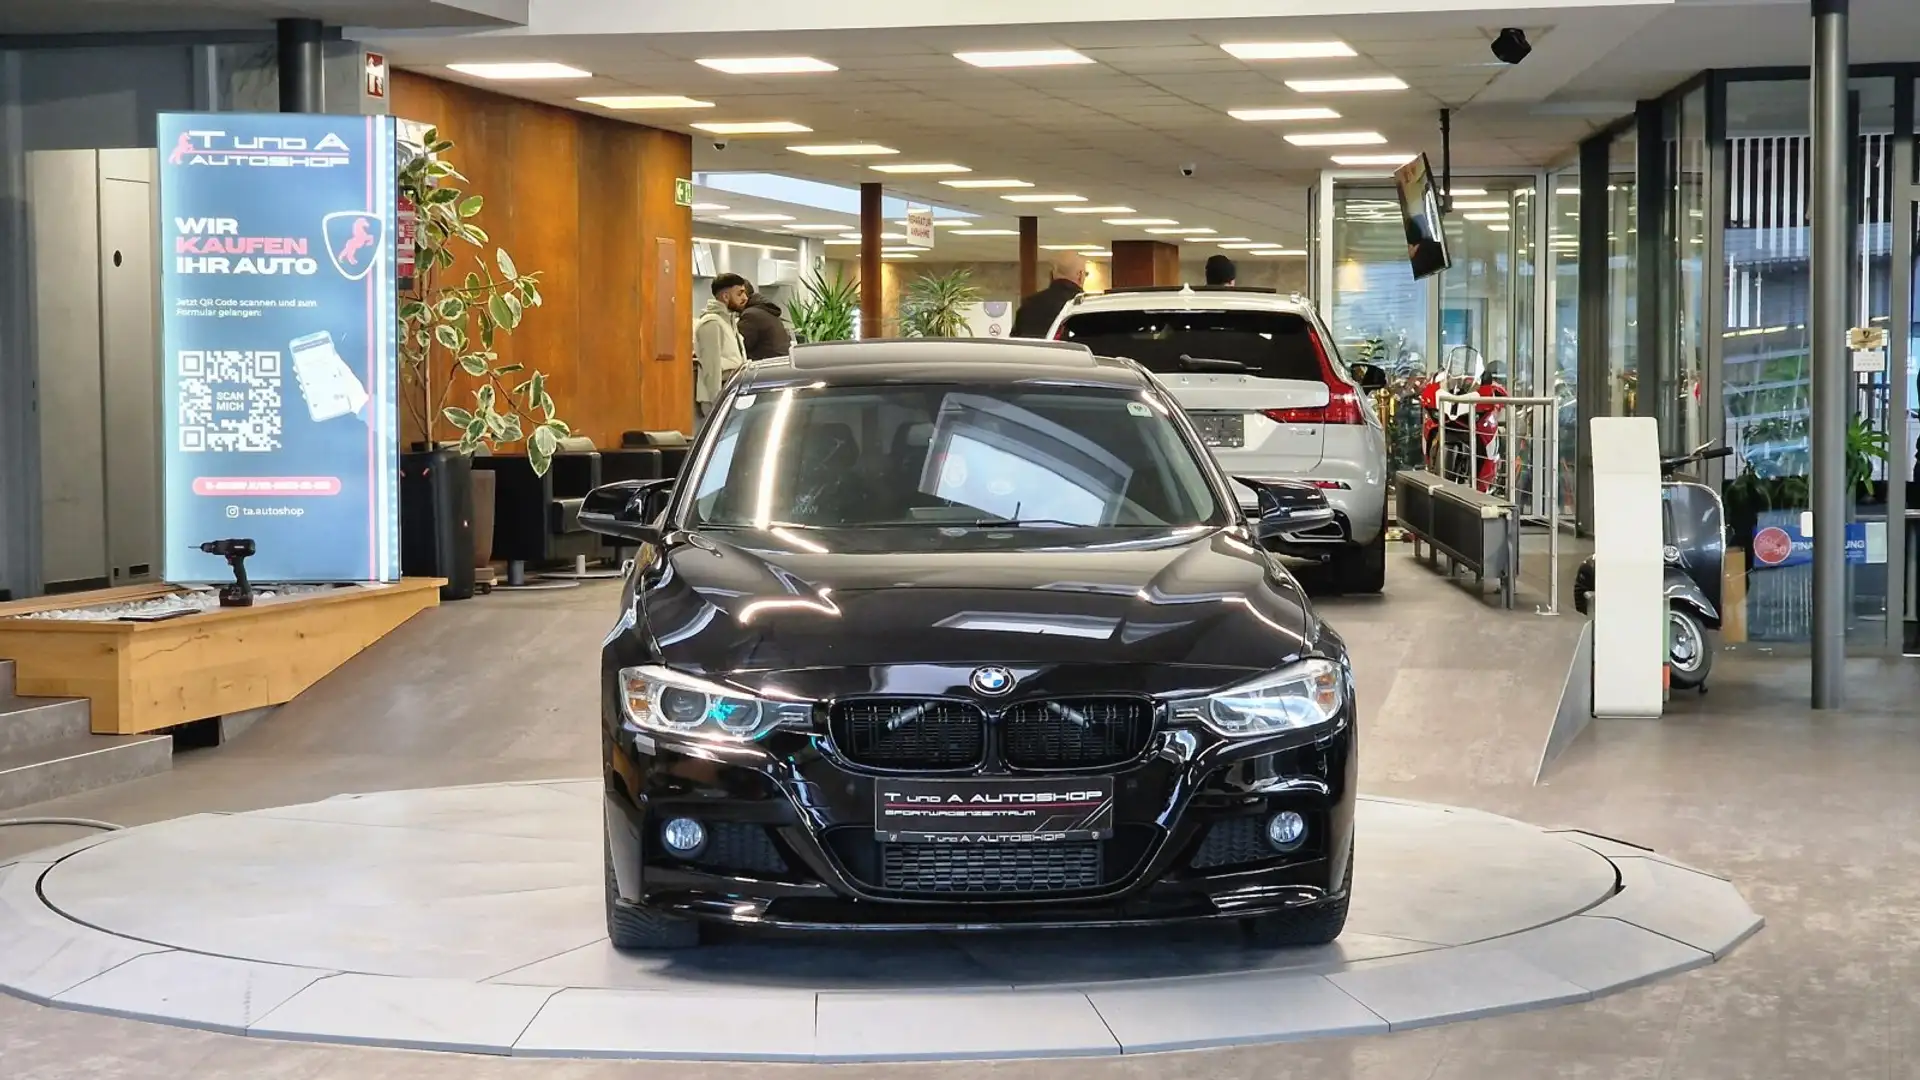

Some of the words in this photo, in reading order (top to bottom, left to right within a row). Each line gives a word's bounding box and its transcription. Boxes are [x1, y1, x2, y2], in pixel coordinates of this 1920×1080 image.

[188, 130, 226, 149] T
[313, 132, 351, 151] A
[188, 154, 350, 167] AUTOSHOP
[174, 217, 238, 235] WIR
[176, 237, 308, 254] KAUFEN
[176, 257, 230, 274] IHR
[232, 258, 318, 275] AUTO
[176, 298, 198, 307] Jetzt
[199, 299, 214, 307] QR
[215, 299, 238, 307] Code
[278, 299, 296, 307] und
[176, 308, 217, 316] Formular
[218, 309, 262, 318] gelangen:
[216, 392, 244, 400] SCAN
[216, 402, 244, 411] MICH
[242, 506, 304, 518] ta.autoshop
[884, 792, 901, 801] T
[947, 794, 964, 803] A
[969, 790, 1103, 803] AUTOSHOP
[923, 834, 935, 842] T
[960, 835, 971, 843] A
[976, 833, 1066, 843] AUTOSHOP
